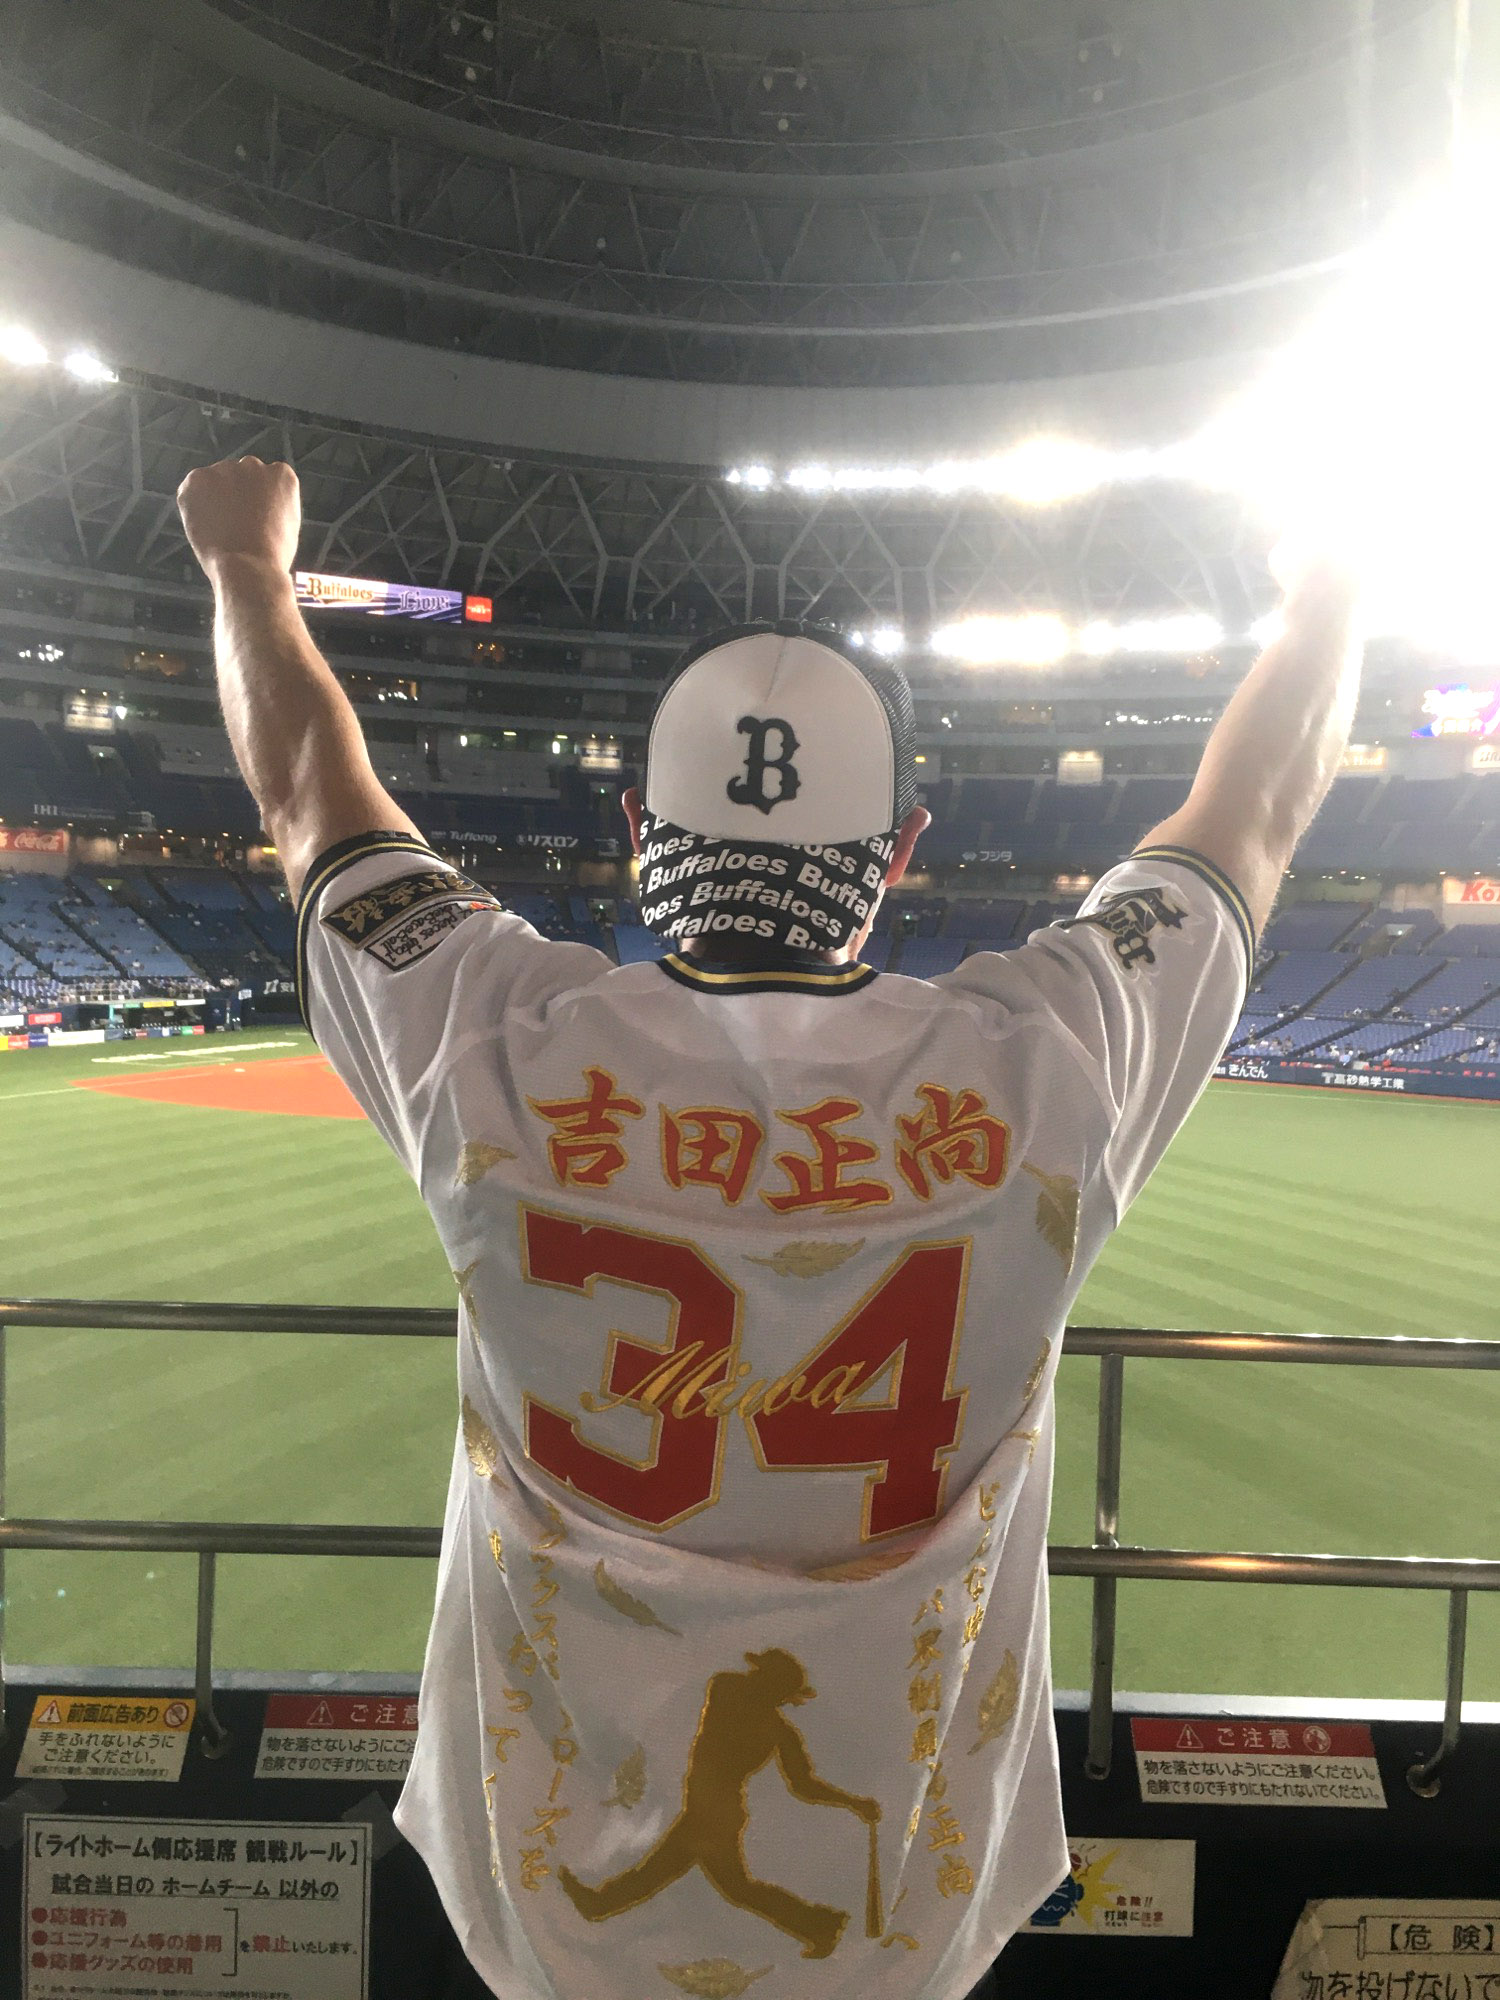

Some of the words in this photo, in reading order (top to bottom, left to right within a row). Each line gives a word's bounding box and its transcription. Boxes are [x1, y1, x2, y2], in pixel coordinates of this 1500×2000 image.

[306, 576, 374, 602] Buffaloes
[726, 715, 802, 816] B
[33, 803, 59, 816] IHI
[449, 830, 498, 845] Tuflong
[646, 848, 789, 895] Buffaloes
[796, 862, 869, 921] Buffa
[689, 878, 843, 938] Buffaloes
[526, 1065, 1012, 1215] 吉田正尚
[518, 1200, 974, 1544] 34
[66, 1701, 160, 1724] 前面広告あり
[350, 1703, 419, 1725] ご注意
[38, 1731, 176, 1749] 手をふれないように
[1216, 1727, 1292, 1750] ご注意
[44, 1748, 157, 1765] ご注意ください。
[1143, 1758, 1376, 1782] 物を落さないようにご注意ください。
[1146, 1778, 1381, 1800] 危険ですので手すりにもたれないでください。
[51, 1873, 155, 1896] 試合当日の
[162, 1876, 271, 1897] ホームチーム
[279, 1878, 340, 1899] 以外の
